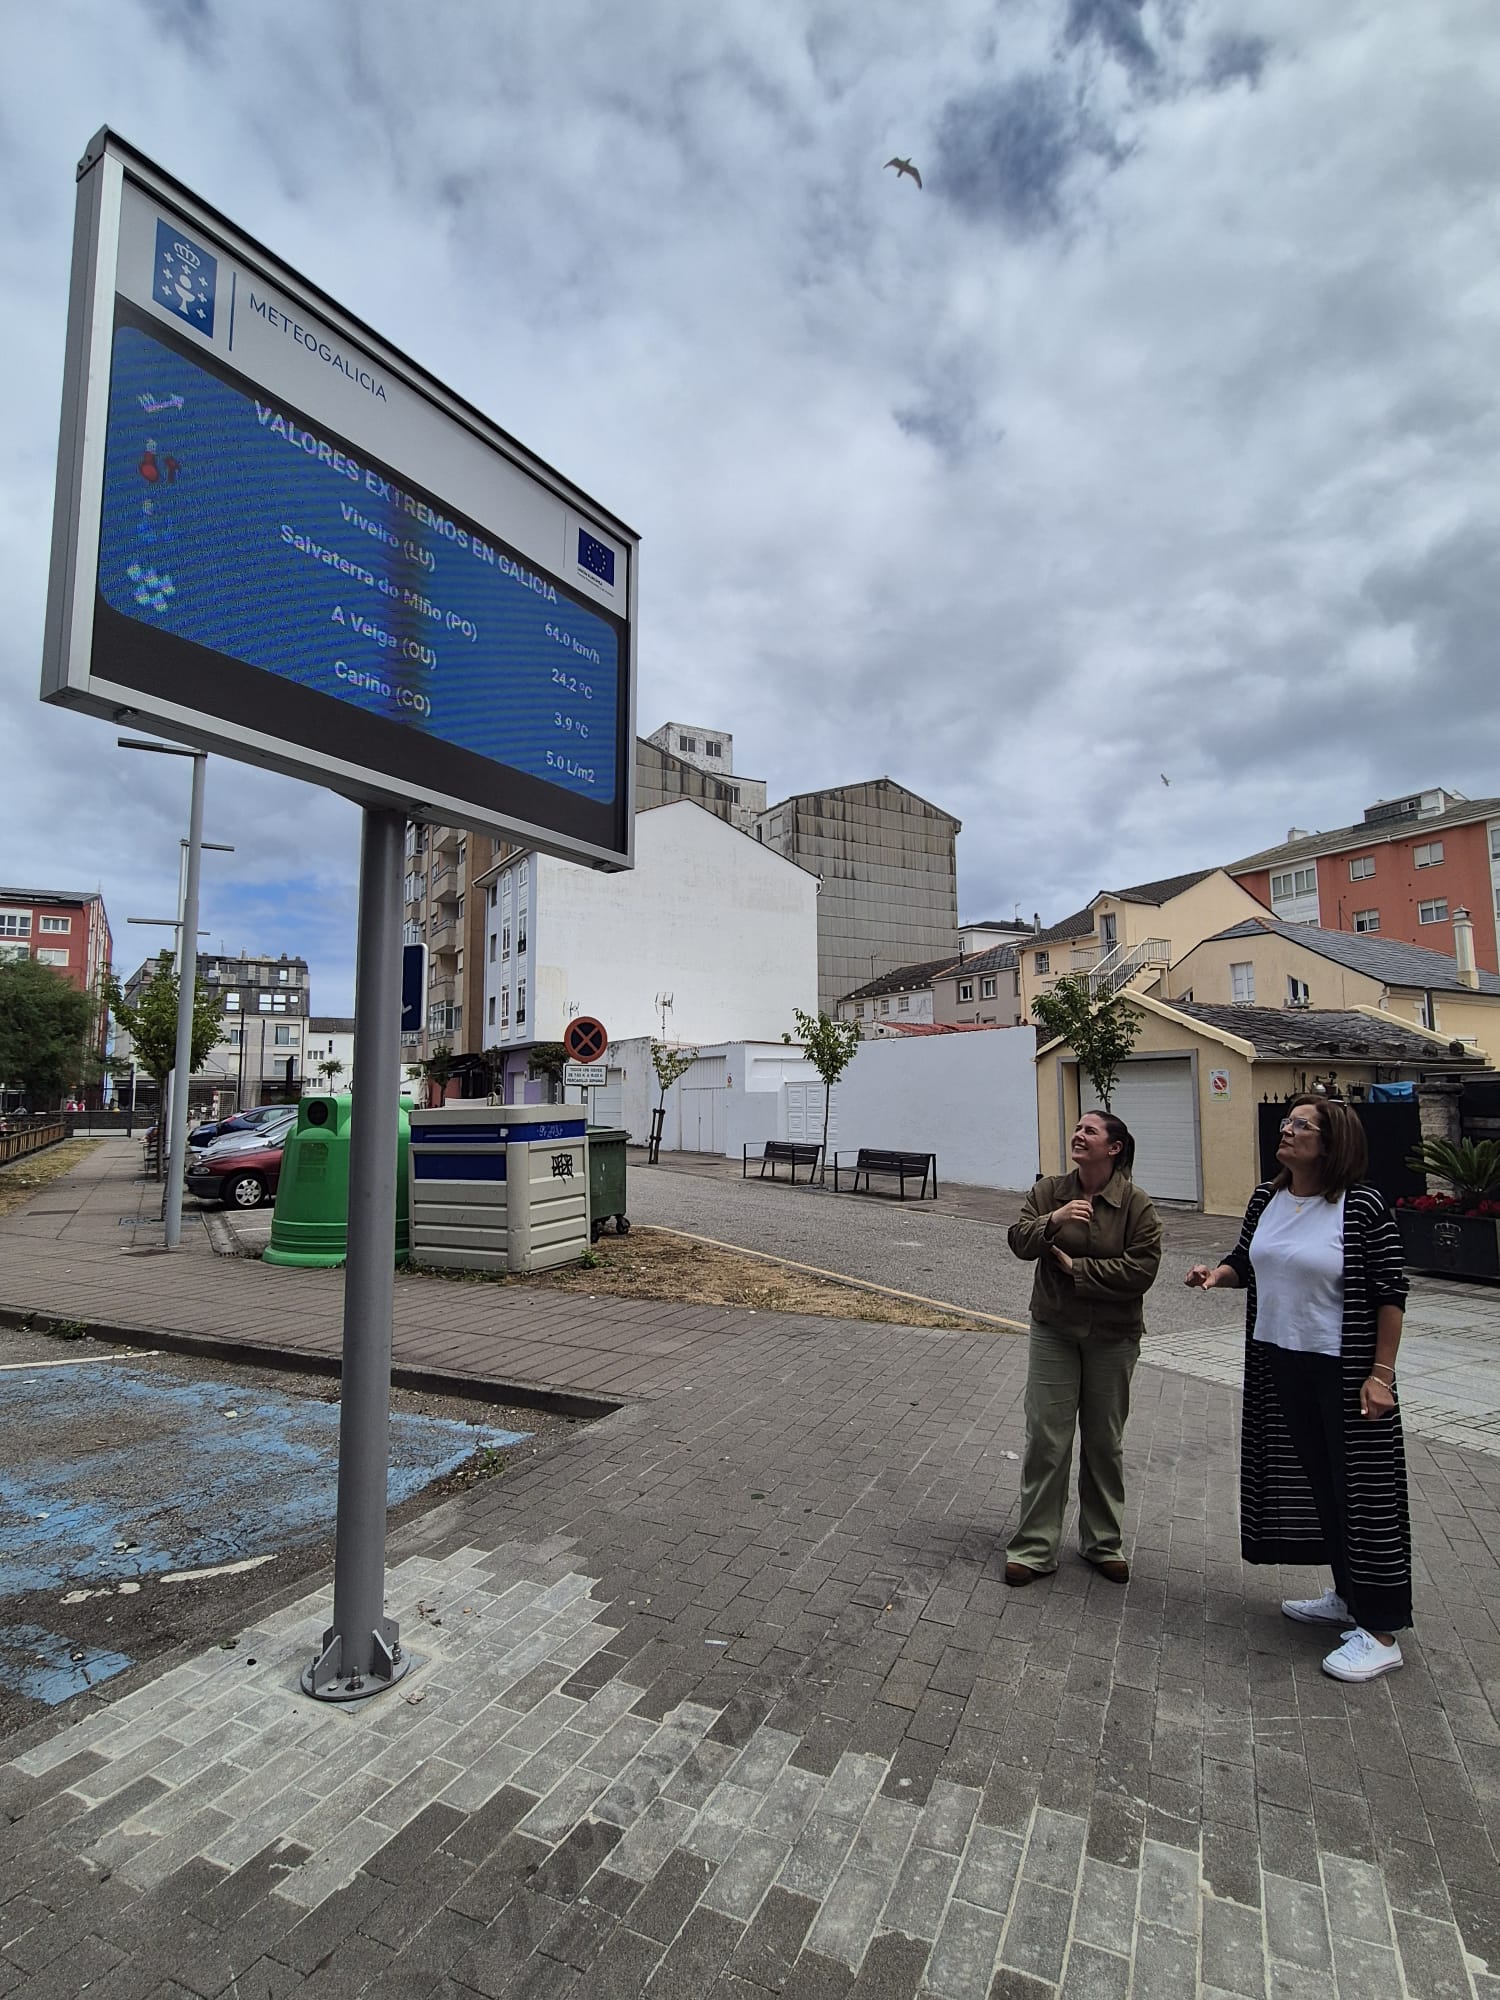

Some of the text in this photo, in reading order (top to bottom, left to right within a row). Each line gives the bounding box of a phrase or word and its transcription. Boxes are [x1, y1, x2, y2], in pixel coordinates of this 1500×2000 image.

[250, 293, 387, 402] METEOGALICIA
[255, 400, 359, 481] VALORES
[366, 469, 468, 549] EXTREMOS
[473, 536, 494, 566] EN
[499, 555, 558, 605] GALICIA
[340, 501, 436, 573] Viveiro (LU)
[281, 524, 477, 643] Salvaterra do Miño (PO)
[332, 605, 437, 671] A Veiga (OU)
[545, 622, 600, 665] 64.0 km/h
[335, 661, 431, 717] Cariño (CO)
[552, 668, 577, 692] 24.2
[554, 711, 572, 731] 3.9
[546, 750, 595, 784] 5.0 L/m2
